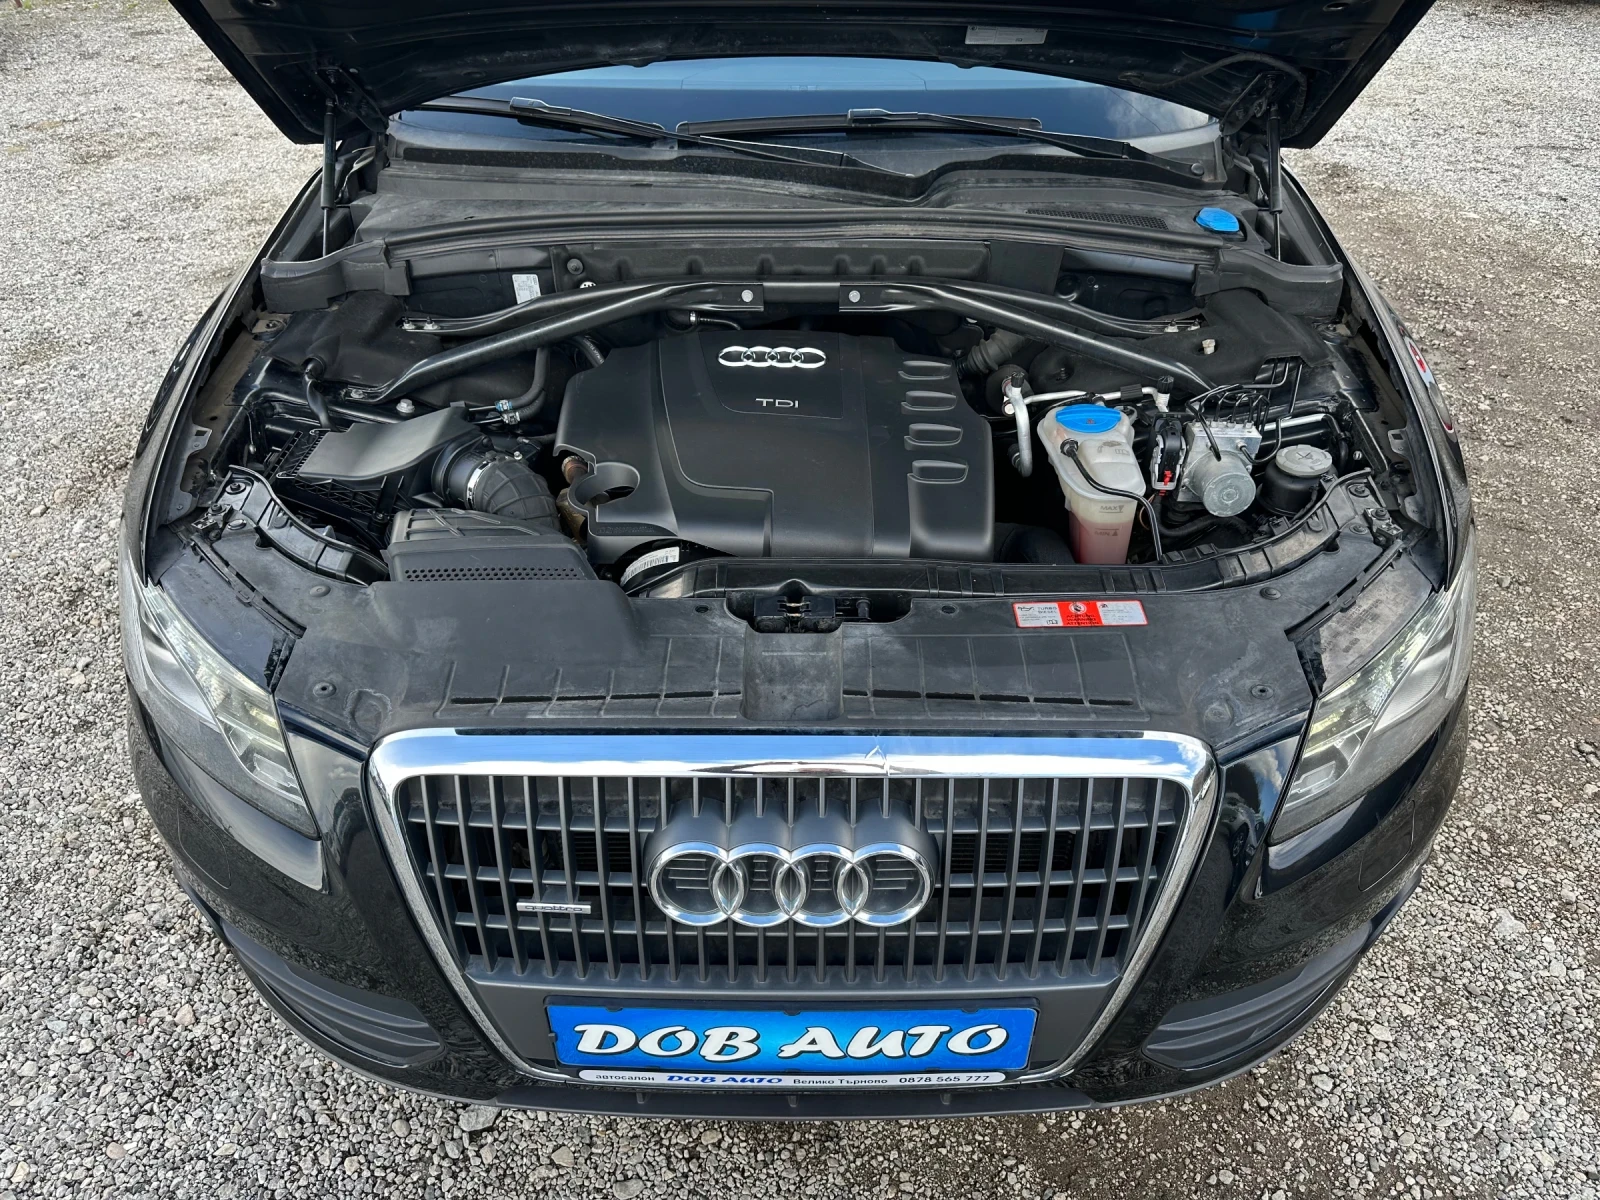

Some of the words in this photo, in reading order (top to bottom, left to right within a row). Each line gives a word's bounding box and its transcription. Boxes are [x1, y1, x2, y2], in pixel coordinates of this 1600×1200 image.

[755, 398, 799, 409] TDI
[573, 1023, 761, 1063] DOB
[776, 1024, 1009, 1060] AUTO
[595, 1074, 655, 1082] автосалон
[667, 1075, 717, 1084] DOB
[793, 1077, 835, 1085] Велико
[838, 1077, 888, 1085] Търново
[898, 1076, 932, 1084] 0878
[936, 1075, 961, 1083] 565
